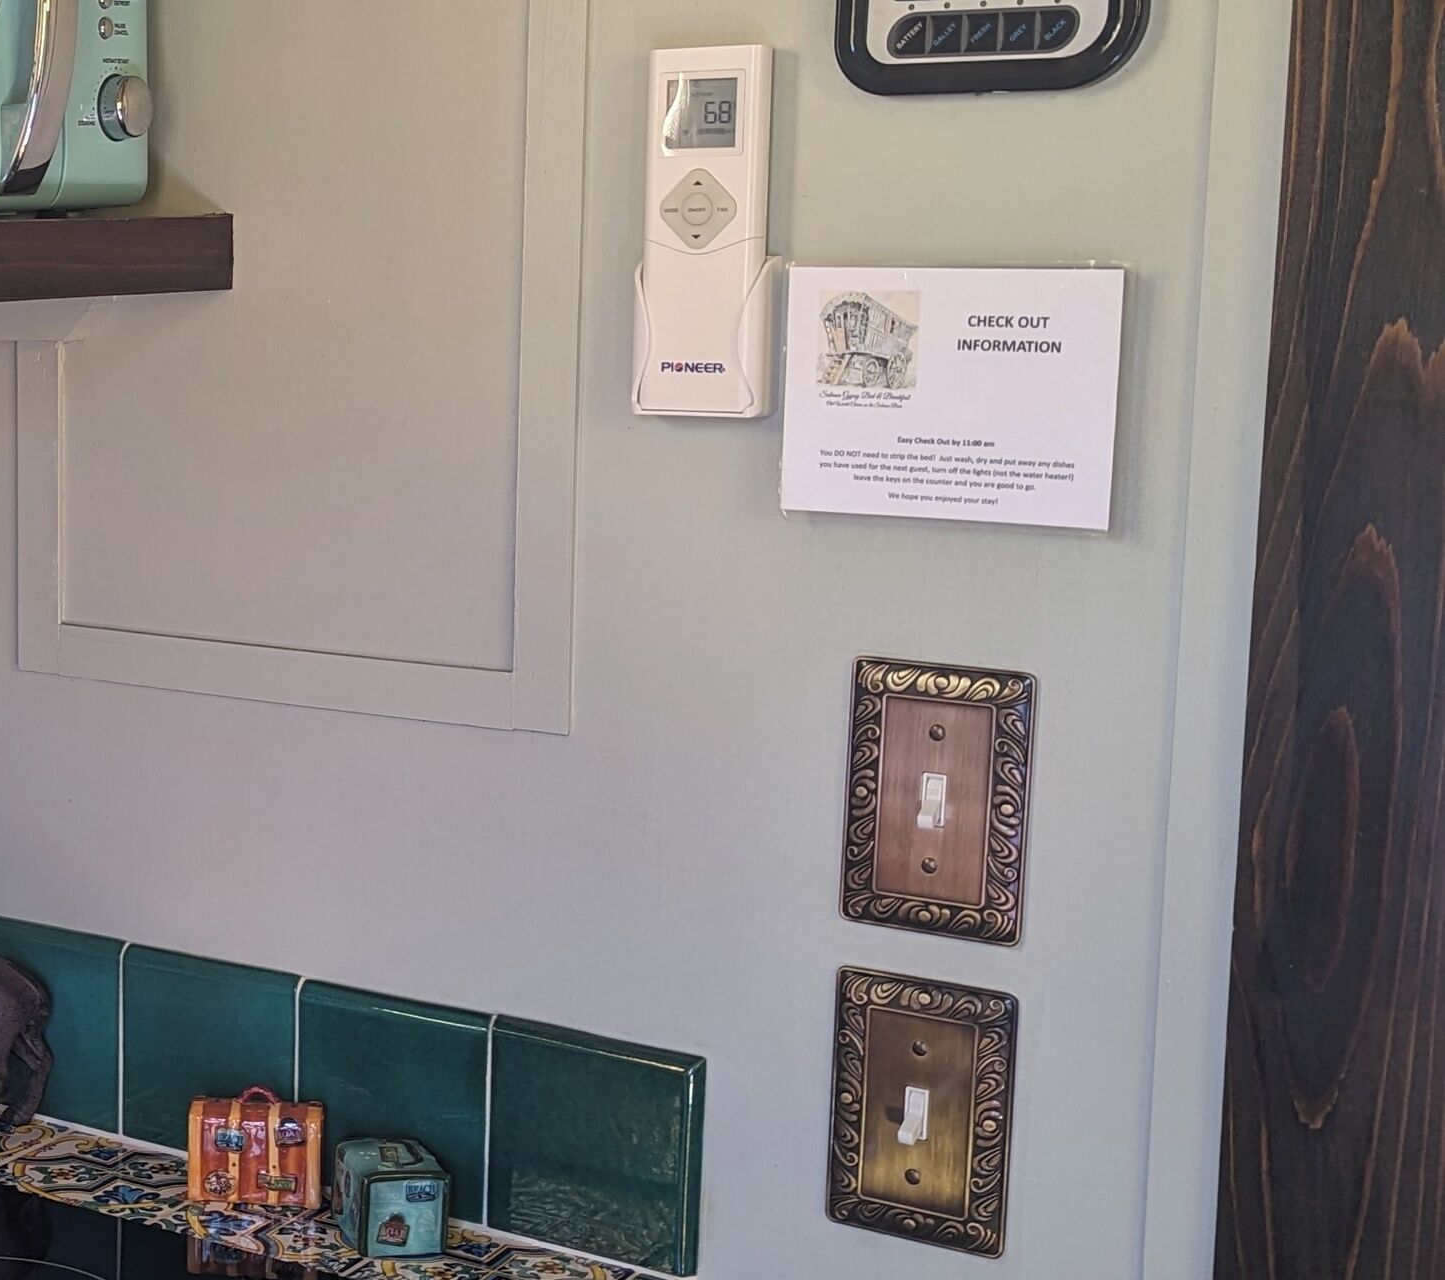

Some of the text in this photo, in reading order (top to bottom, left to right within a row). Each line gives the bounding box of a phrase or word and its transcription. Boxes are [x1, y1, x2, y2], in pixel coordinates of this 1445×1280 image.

[896, 21, 923, 50] BATTERY
[1009, 23, 1027, 42] GREY
[1043, 19, 1067, 41] BLACK
[704, 101, 731, 124] 68
[967, 315, 1050, 329] CHECK OUT
[956, 339, 1062, 354] INFORMATION
[661, 361, 725, 374] PIONEER
[897, 436, 912, 444] Easy
[951, 438, 960, 447] by
[975, 456, 987, 465] dry
[1052, 460, 1074, 468] dishes
[868, 462, 878, 470] for
[972, 468, 991, 476] lights
[992, 469, 1007, 477] (not
[853, 473, 871, 481] leave
[885, 475, 900, 483] keys
[900, 492, 918, 500] hope
[934, 495, 962, 503] enjoyed
